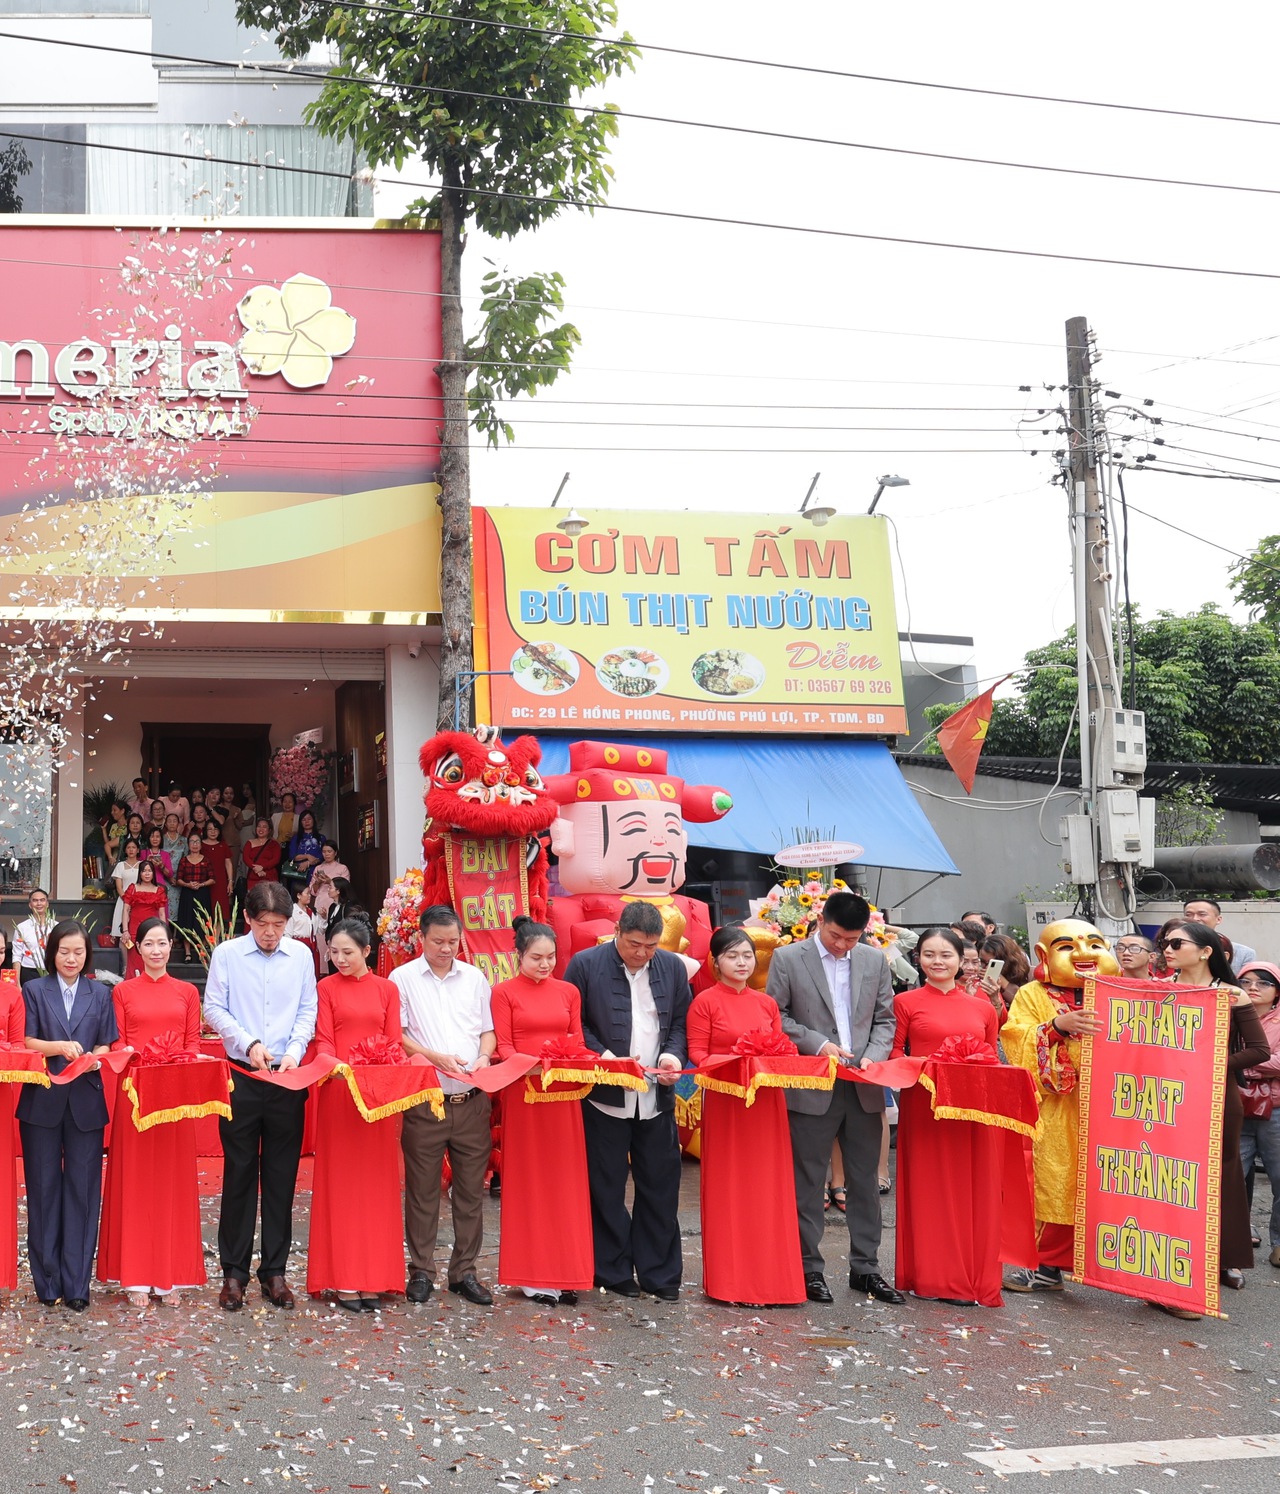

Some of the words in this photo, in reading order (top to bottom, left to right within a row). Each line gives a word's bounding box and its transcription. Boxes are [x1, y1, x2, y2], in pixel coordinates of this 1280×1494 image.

[48, 405, 103, 438] Spa
[107, 402, 148, 441] by
[150, 405, 250, 440] ROYAL
[535, 528, 680, 575] CƠM
[704, 526, 852, 579] TẤM
[520, 583, 609, 625] BÚN
[622, 592, 713, 635] THỊT
[726, 588, 872, 632] NƯỚNG
[785, 641, 882, 671] Diễm
[784, 679, 804, 692] ĐT:
[808, 679, 845, 692] 03567
[850, 680, 865, 693] 69
[869, 680, 892, 694] 326
[511, 707, 534, 718] ĐC:
[538, 707, 557, 718] 29
[561, 705, 578, 719] LÊ
[583, 704, 620, 719] HỒNG
[625, 709, 676, 722] PHONG,
[680, 709, 736, 722] PHƯỜNG
[740, 709, 767, 722] PHÚ
[772, 710, 798, 725] LỢI,
[803, 712, 824, 723] TP.
[829, 712, 862, 724] TDM.
[867, 713, 885, 724] BD
[461, 838, 509, 880] ĐẠI
[461, 886, 516, 930] CÁT
[1108, 993, 1203, 1051] PHÁT
[1112, 1073, 1184, 1132] ĐẠT
[1097, 1142, 1199, 1210] THÀNH
[1096, 1216, 1193, 1287] CÔNG
